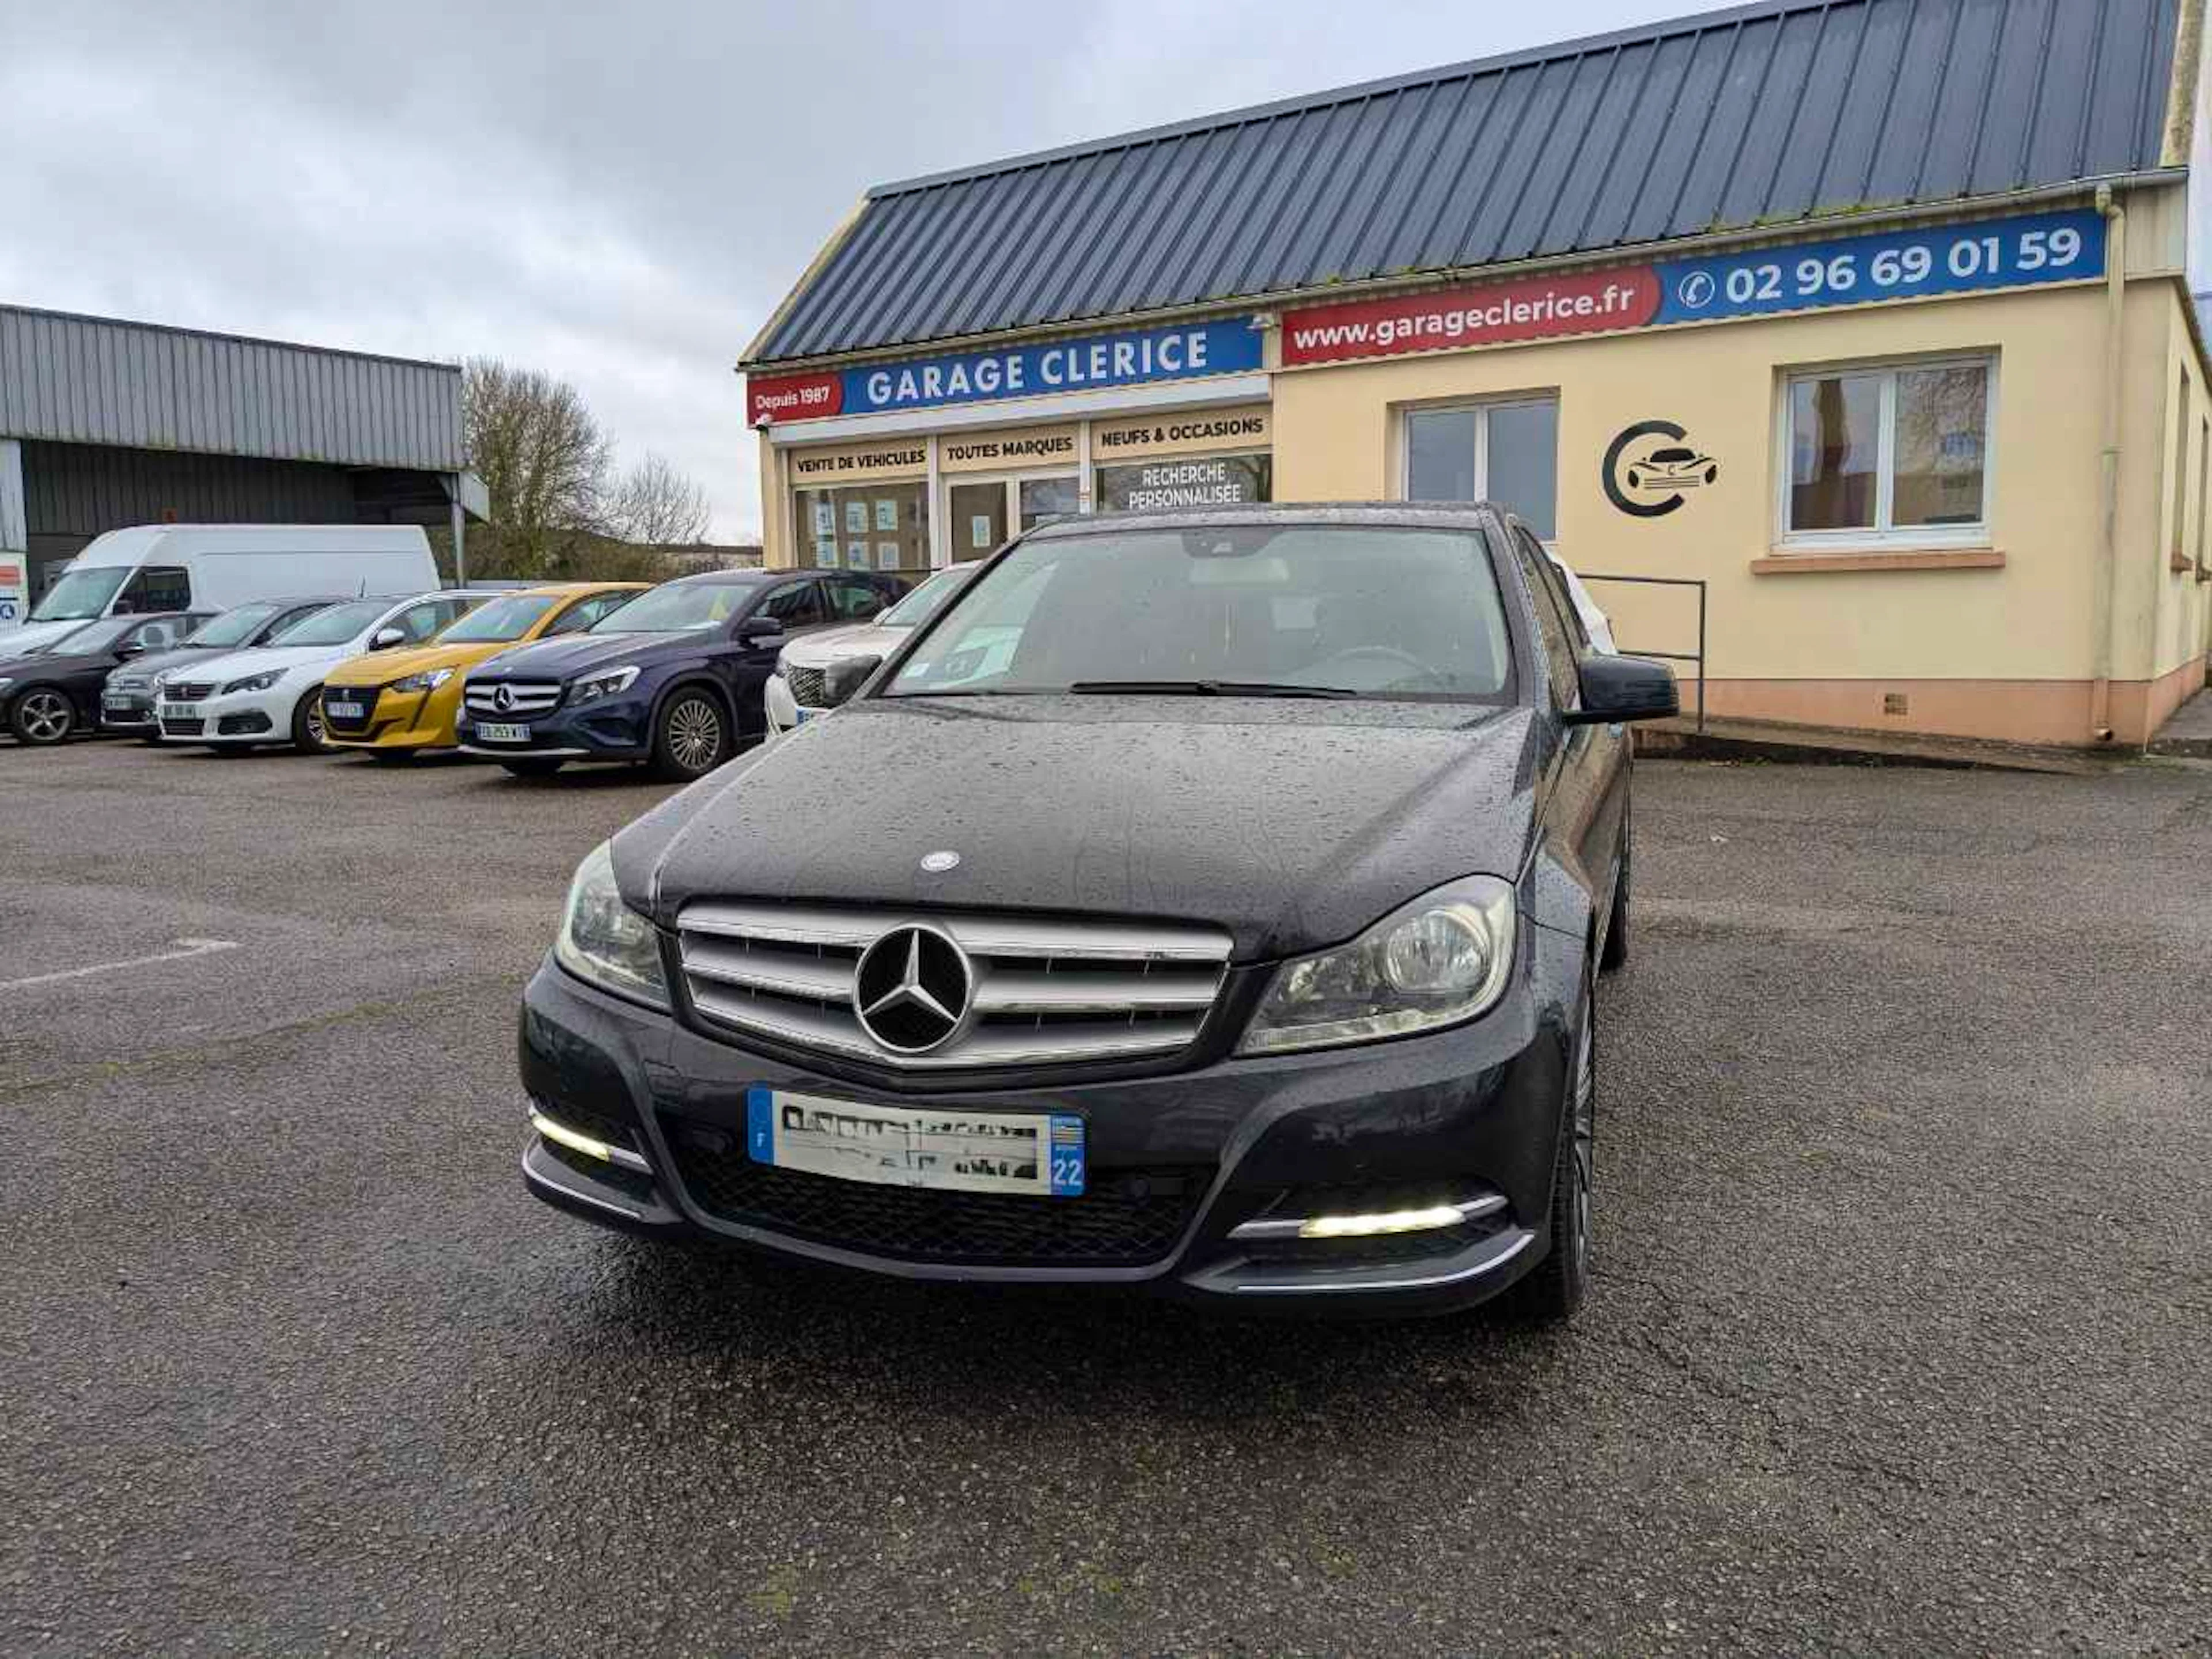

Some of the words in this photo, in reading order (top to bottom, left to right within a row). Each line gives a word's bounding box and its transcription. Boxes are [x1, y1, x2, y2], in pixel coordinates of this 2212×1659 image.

[1728, 264, 1783, 304] 02
[1796, 255, 1856, 295] 96
[1870, 245, 1933, 286] 69
[1948, 236, 2000, 278] 01
[2017, 227, 2081, 270] 59
[1293, 285, 1635, 350] www.garageclerice.fr
[868, 354, 1024, 404] GARAGE
[1040, 331, 1207, 385] CLERICE
[755, 389, 798, 413] Depuis
[799, 385, 831, 404] 1987
[1102, 429, 1150, 446] NEUFS
[1154, 427, 1165, 442] &
[1170, 418, 1264, 441] OCCASIONS
[797, 457, 834, 472] VENTE
[839, 457, 854, 469] DE
[857, 449, 926, 468] VEHICULES
[948, 442, 1000, 460] TOUTES
[1002, 436, 1074, 457] MARQUES
[1142, 462, 1225, 487] RECHERCHE
[1053, 1159, 1082, 1187] 22
